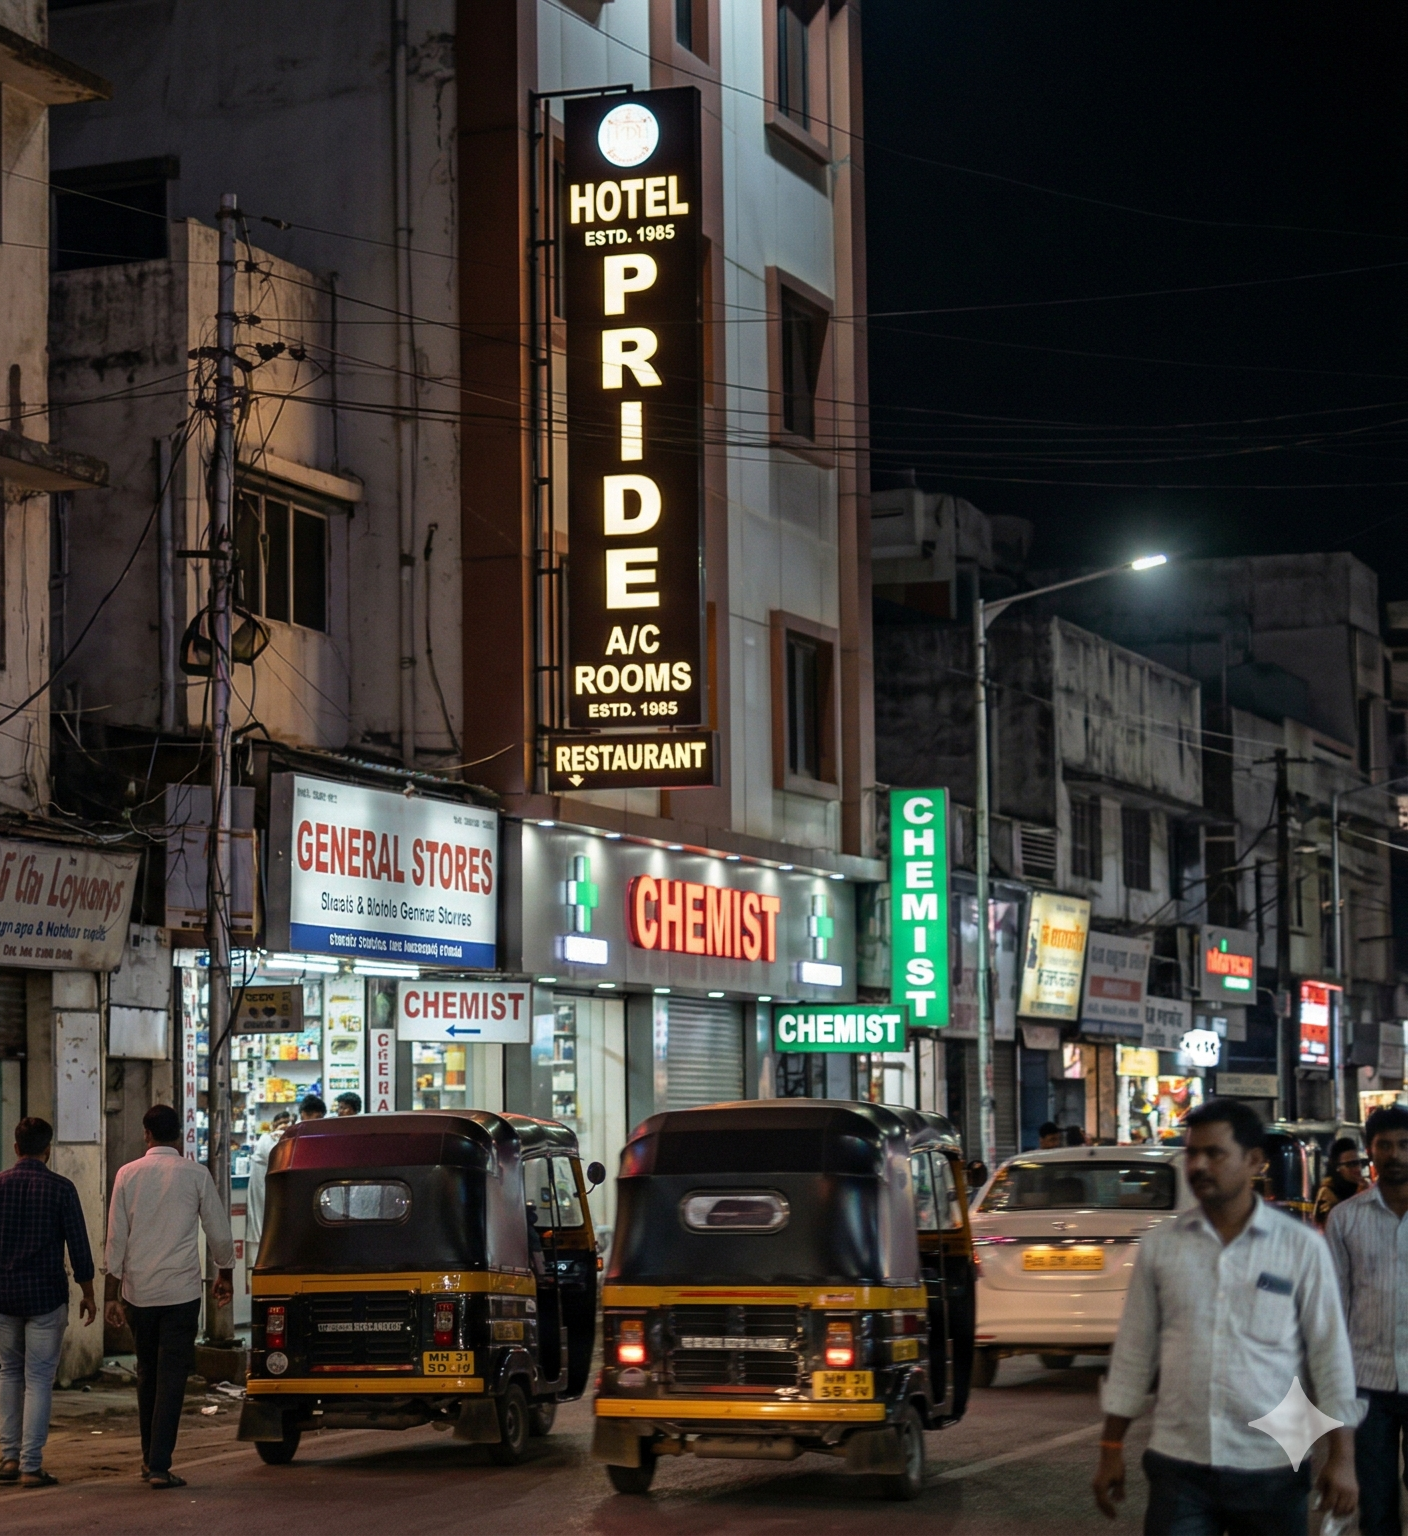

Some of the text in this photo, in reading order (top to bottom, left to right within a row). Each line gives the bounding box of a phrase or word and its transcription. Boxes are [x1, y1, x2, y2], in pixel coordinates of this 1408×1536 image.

[570, 175, 689, 224] HOTEL
[585, 224, 675, 246] ESTD. 1985
[601, 253, 663, 610] PRIDE
[605, 624, 660, 656] A/C
[575, 661, 692, 695] ROOMS
[588, 701, 678, 717] ESTD. 1985
[556, 742, 707, 772] RESTAURANT
[297, 820, 493, 895] GENERAL STORES
[357, 896, 364, 915] &
[632, 873, 781, 963] CHEMIST
[902, 796, 938, 1018] CHEMIST
[404, 990, 525, 1021] CHEMIST
[778, 1014, 901, 1044] CHEMIST
[455, 1353, 469, 1362] 31
